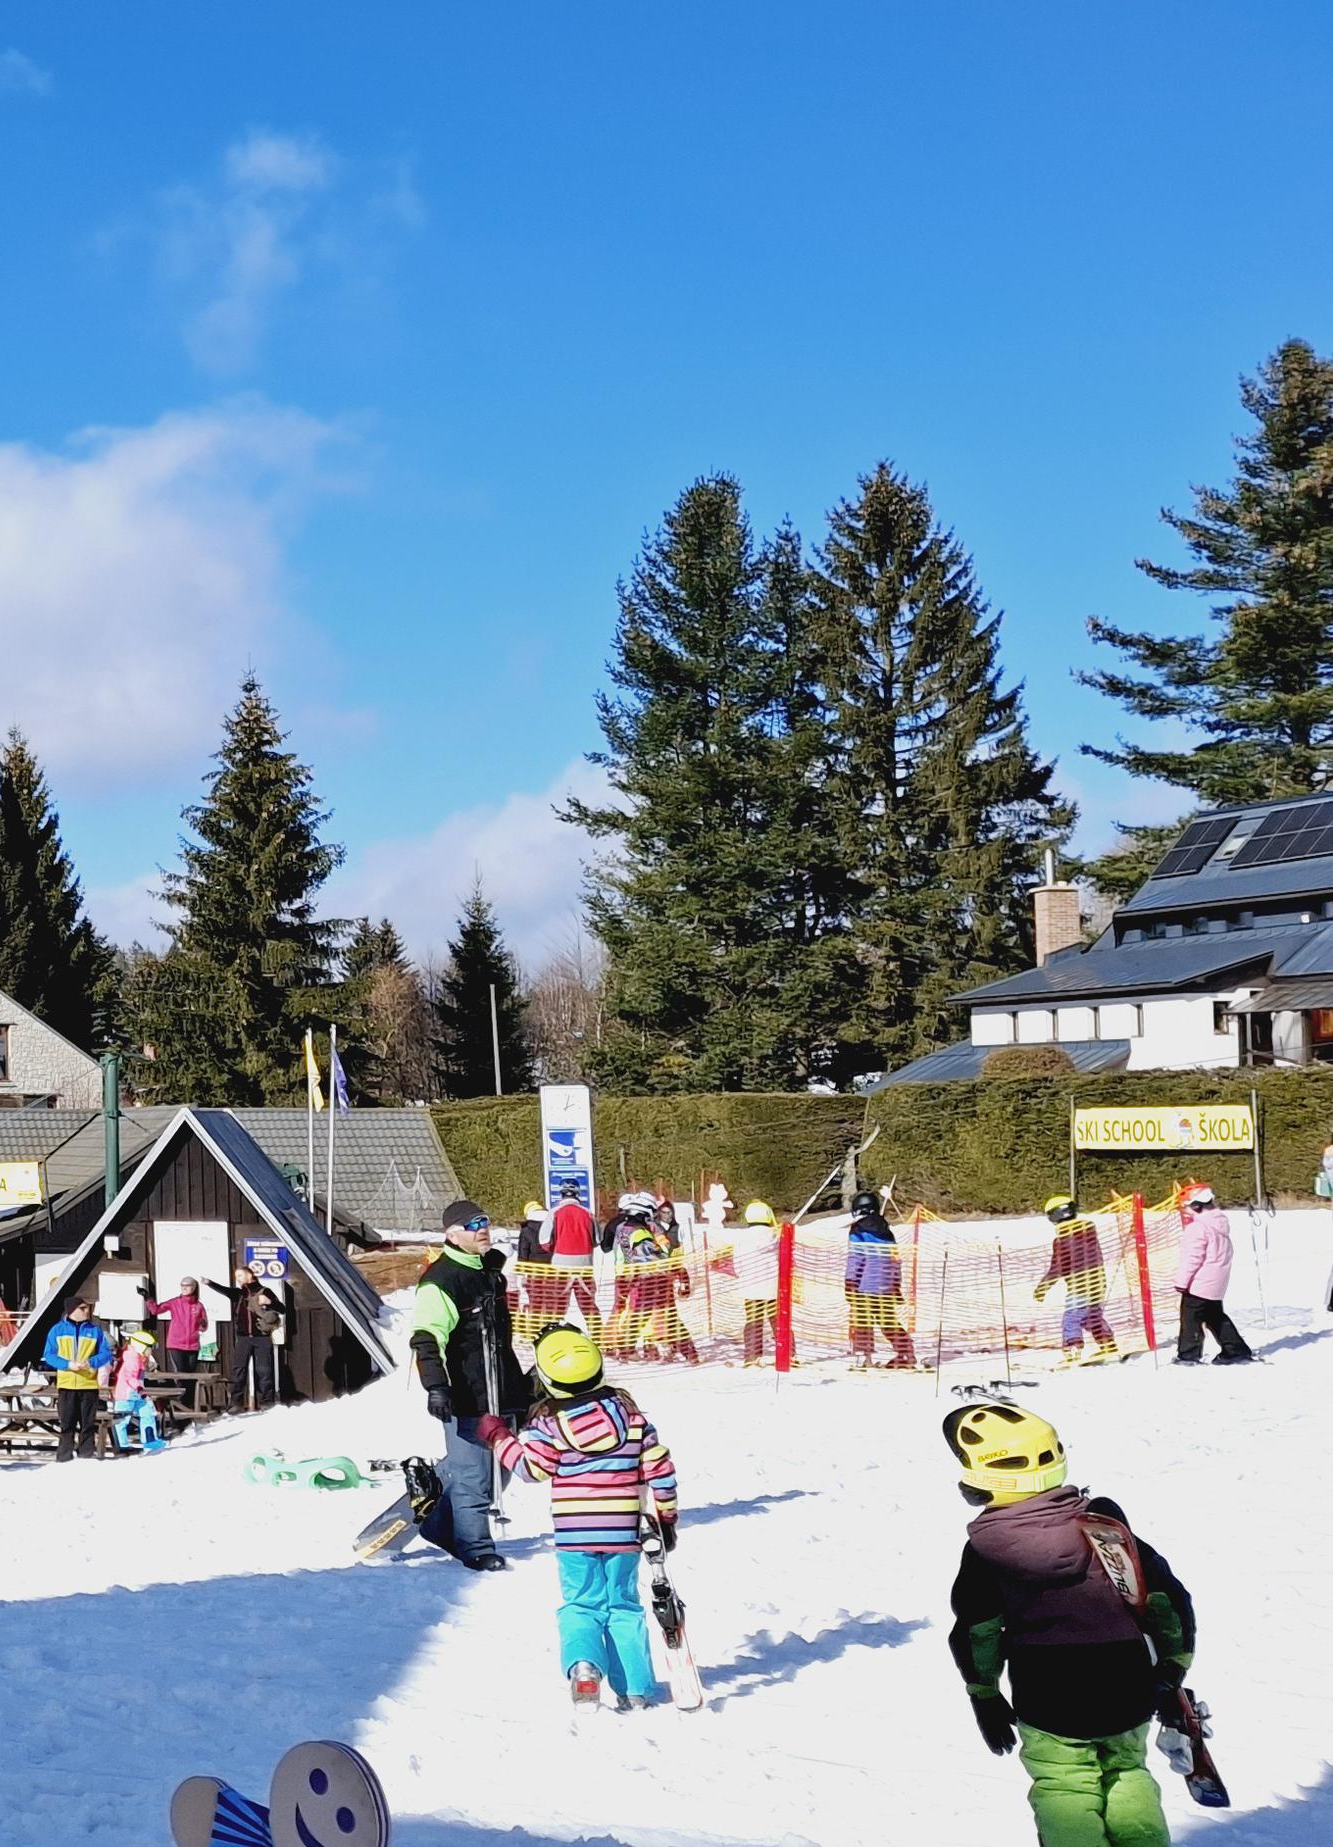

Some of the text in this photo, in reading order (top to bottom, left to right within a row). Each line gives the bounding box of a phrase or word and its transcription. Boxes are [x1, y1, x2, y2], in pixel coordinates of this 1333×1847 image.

[1077, 1112, 1251, 1143] SKI SCHOOL ŠKOLA
